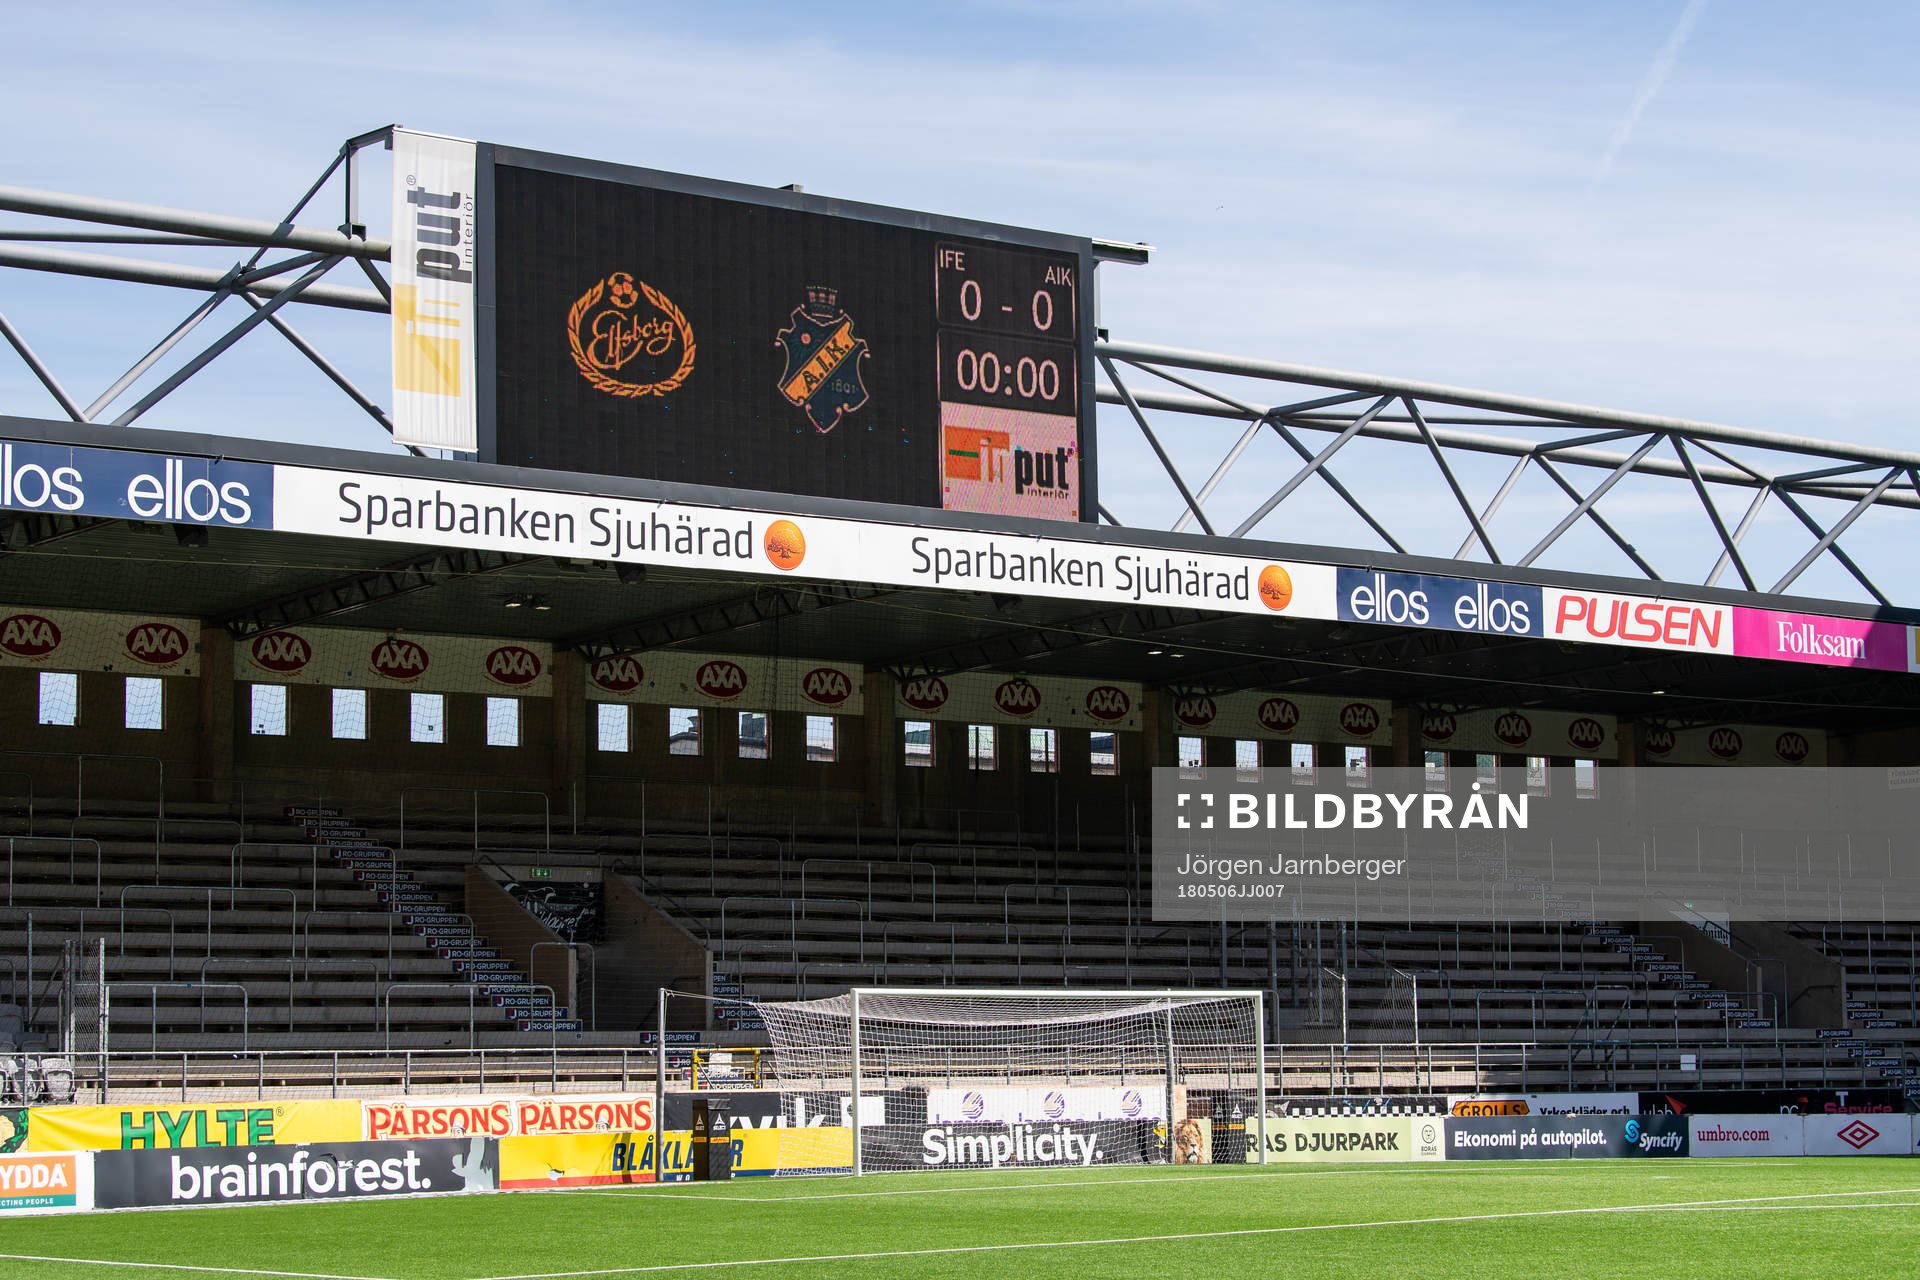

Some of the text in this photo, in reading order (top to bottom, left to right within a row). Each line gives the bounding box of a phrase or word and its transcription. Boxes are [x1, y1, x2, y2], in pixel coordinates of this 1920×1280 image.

[939, 249, 1072, 287] IFE AIK
[960, 280, 982, 321] 0
[1032, 289, 1053, 331] 0
[957, 348, 1060, 401] 00:00
[127, 458, 251, 524] ellos
[338, 482, 754, 558] Sparbanken Sjuhärad
[911, 537, 1250, 600] Sparbanken Sjuhärad
[1350, 573, 1430, 625] ellos
[1454, 583, 1531, 634] ellos
[1, 619, 56, 647] AXA
[1554, 594, 1723, 648] PULSEN
[130, 626, 184, 655] AXA
[257, 636, 306, 663] AXA
[1776, 620, 1868, 660] Folksam
[376, 645, 425, 671] AXA
[490, 651, 537, 677] AXA
[595, 658, 641, 684] AXA
[700, 664, 744, 689] AXA
[808, 671, 849, 697] AXA
[905, 679, 944, 702] AXA
[1000, 684, 1038, 708] AXA
[1090, 689, 1127, 713] AXA
[1178, 698, 1214, 719] AXA
[1262, 701, 1297, 724] AXA
[1343, 705, 1378, 728] AXA
[1499, 716, 1530, 737] AXA
[1571, 721, 1603, 742] AXA
[1710, 730, 1741, 751] AXA
[1777, 735, 1808, 756] AXA
[415, 916, 458, 924] RO-GRUPPEN
[427, 927, 471, 935] RO-GRUPPEN
[120, 1108, 275, 1150] HYLTE
[369, 1103, 511, 1140] PÄRSONS
[519, 1099, 653, 1135] PÄRSONS
[922, 1123, 1104, 1168] Simplicity.
[1295, 1132, 1399, 1152] DJURPARK
[1454, 1128, 1607, 1150] Ekonomi på autopilot.
[1639, 1132, 1683, 1151] Syncify
[1697, 1124, 1770, 1142] umbro.com
[171, 1150, 432, 1199] brainforest.
[26, 1198, 54, 1206] PEOPLE
